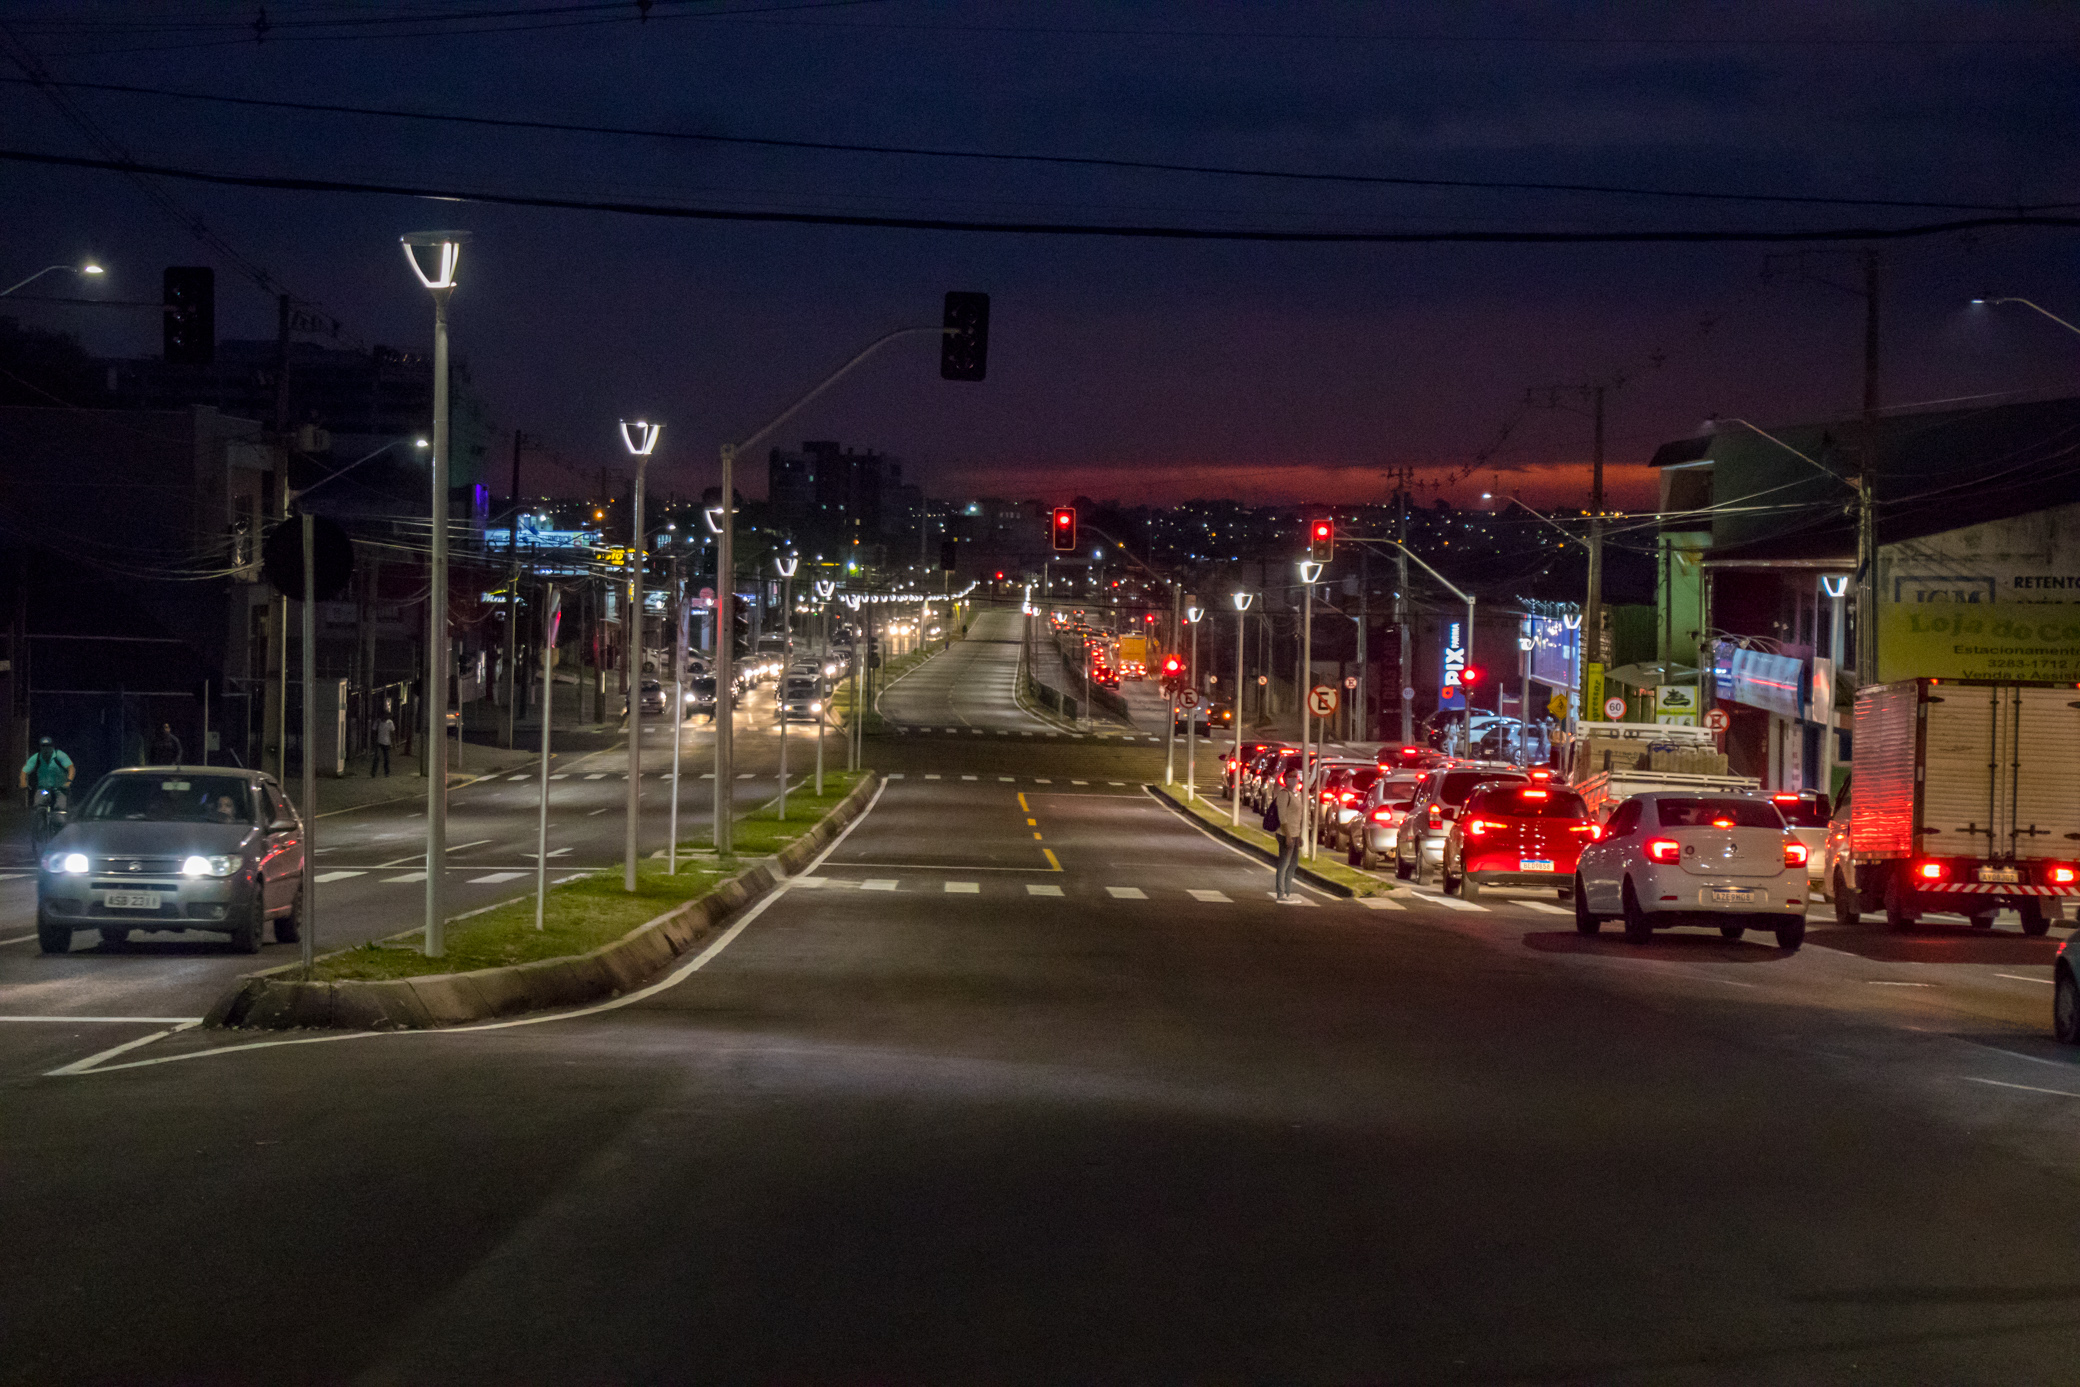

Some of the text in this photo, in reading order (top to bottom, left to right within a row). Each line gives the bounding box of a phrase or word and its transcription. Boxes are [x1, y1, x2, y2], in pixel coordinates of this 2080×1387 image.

[1910, 613, 1983, 637] Loja
[1991, 619, 2033, 640] do
[1444, 647, 1464, 686] PIX
[1609, 702, 1621, 711] 60
